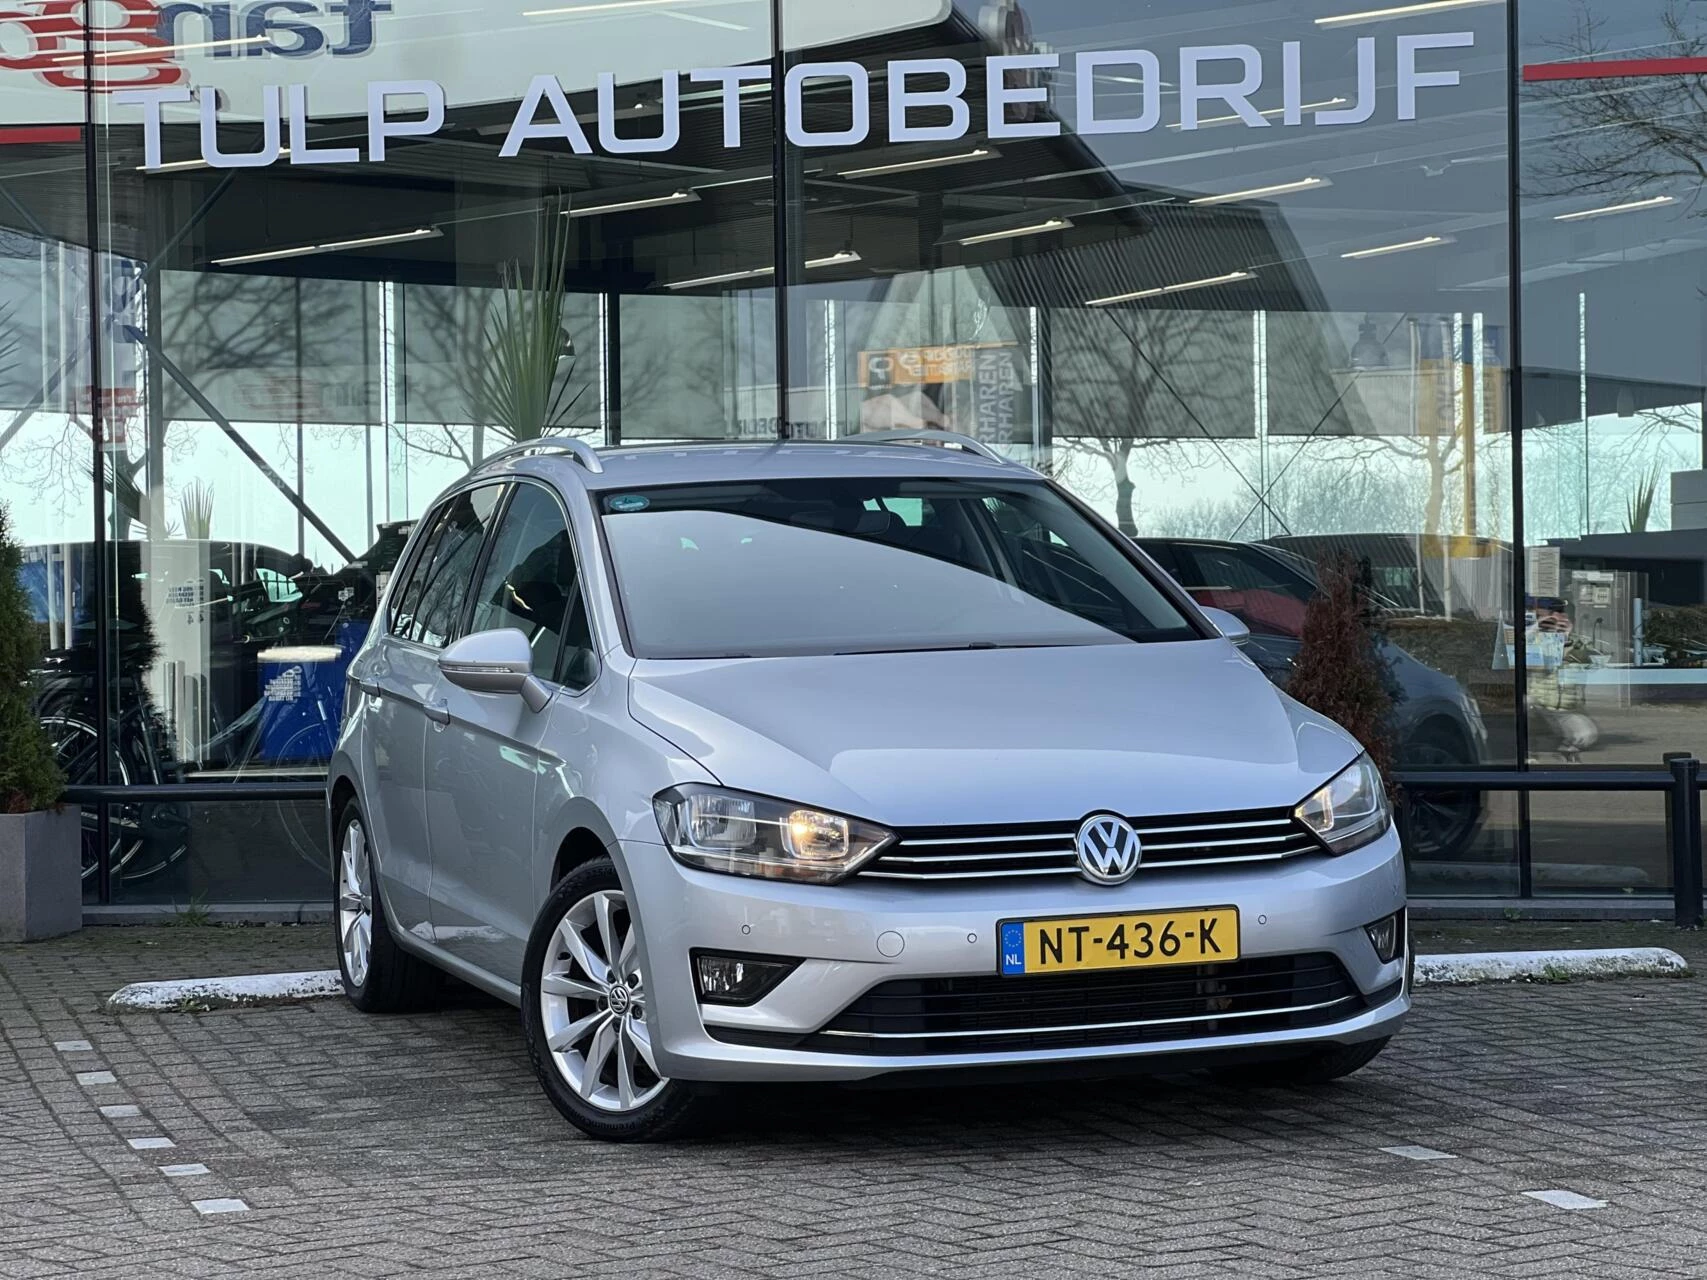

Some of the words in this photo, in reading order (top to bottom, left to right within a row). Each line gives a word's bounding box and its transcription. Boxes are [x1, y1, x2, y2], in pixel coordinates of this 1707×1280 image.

[112, 79, 445, 169] TULP
[498, 32, 1475, 158] AUTOBEDRIJF
[1005, 954, 1022, 966] NL
[1039, 918, 1221, 965] NT-436-K
